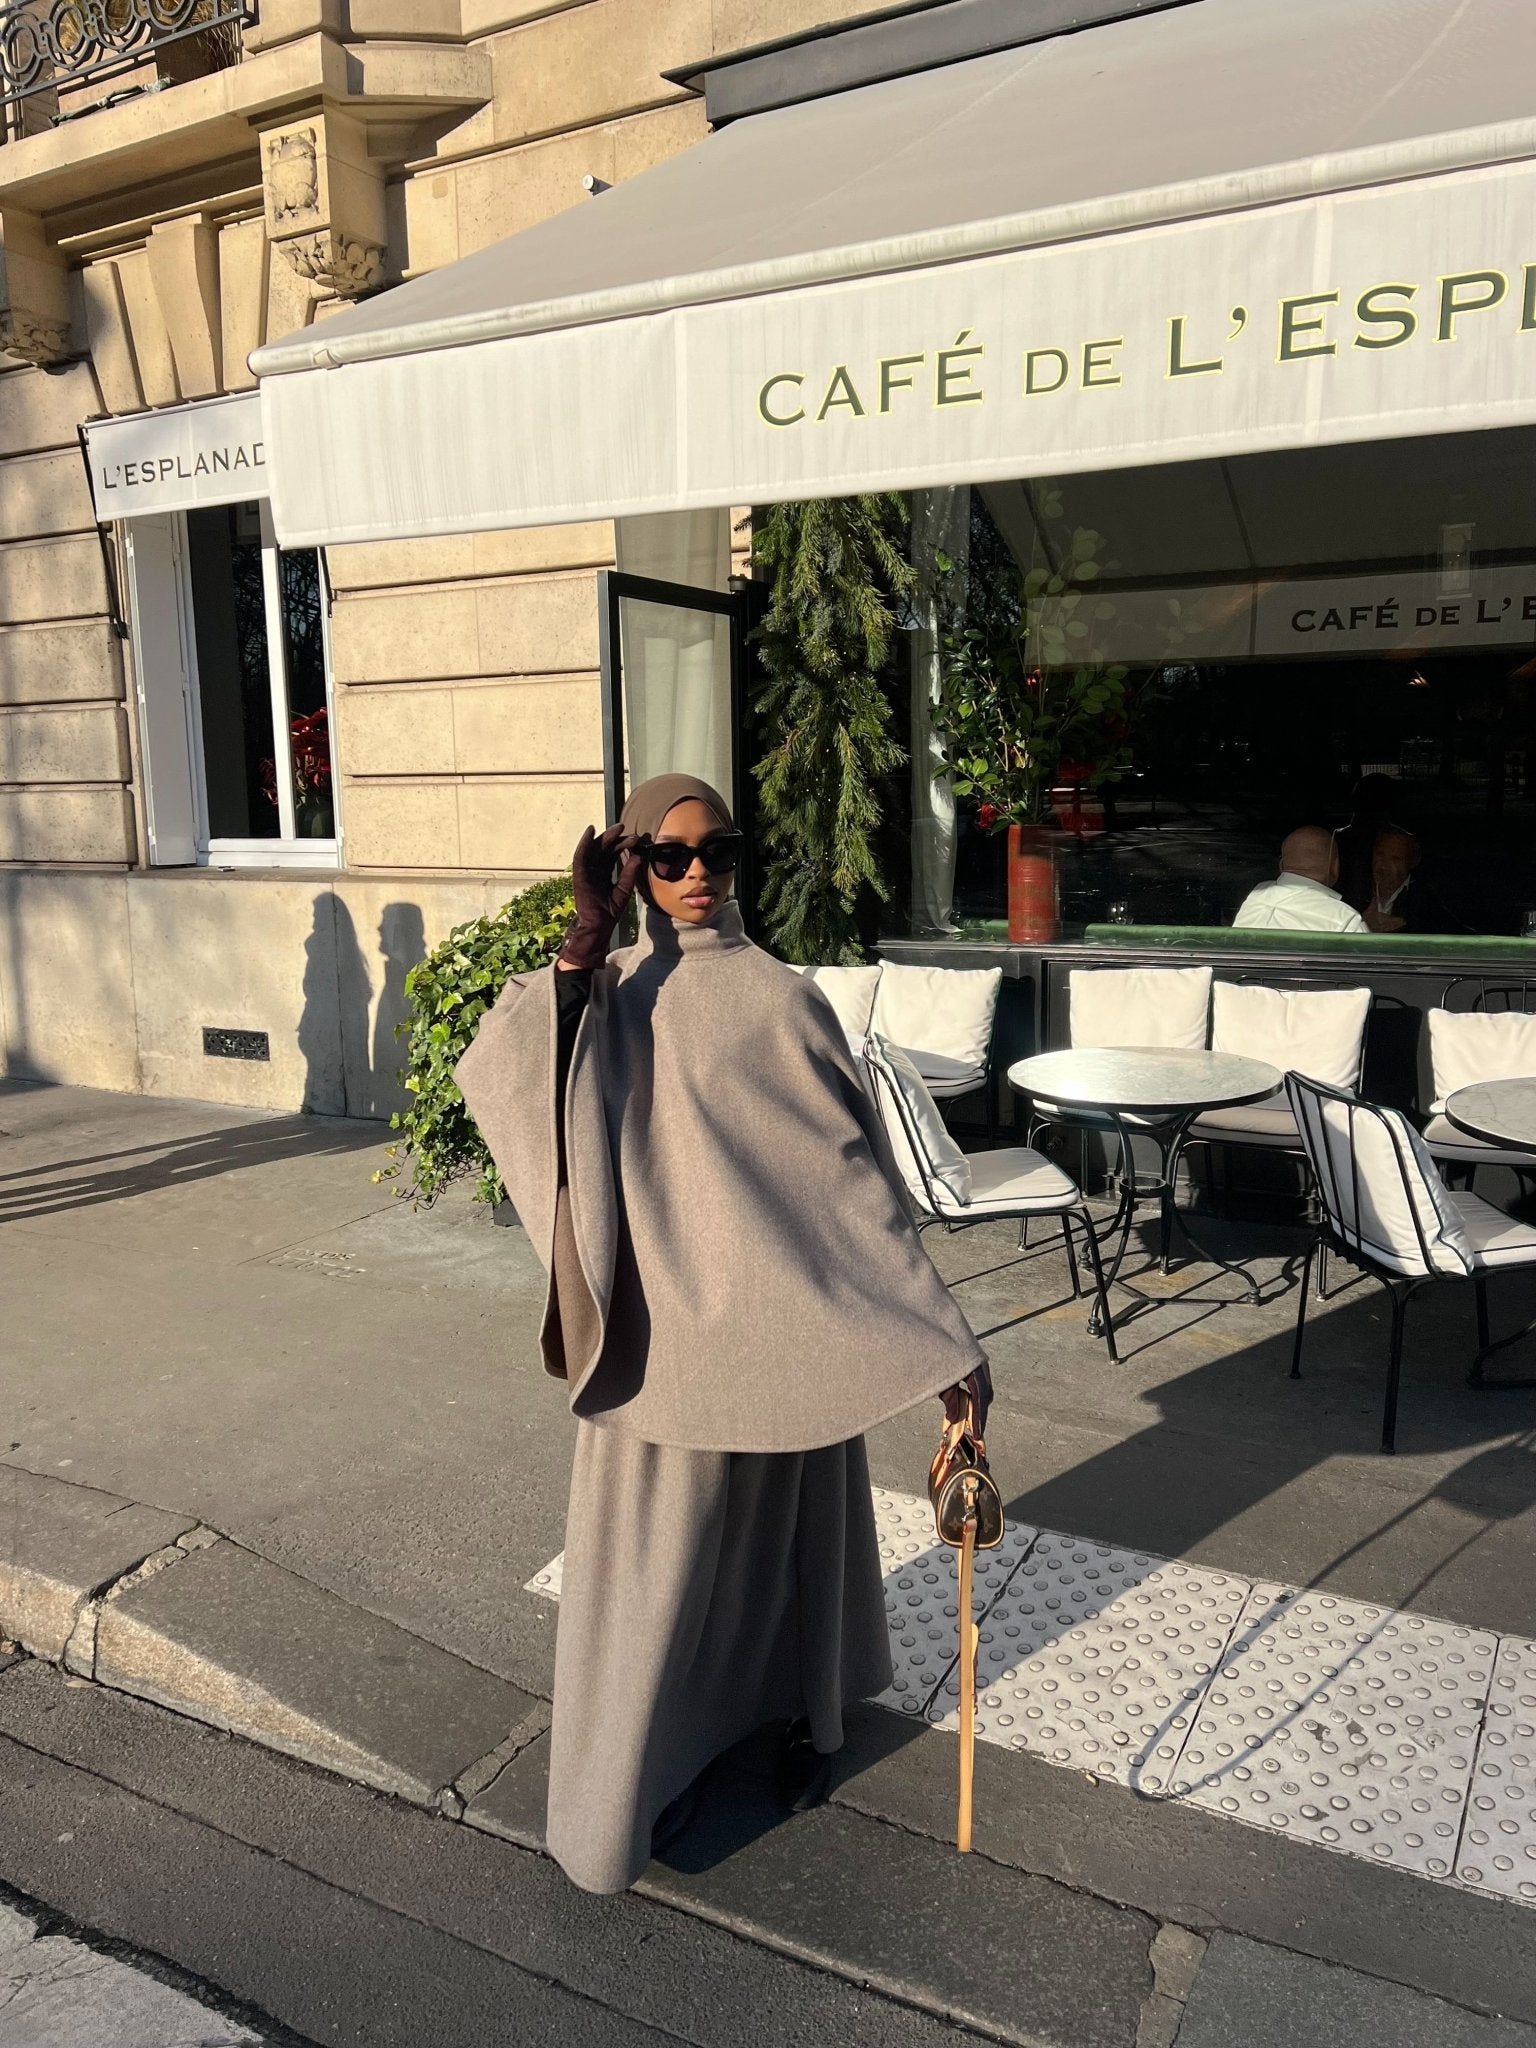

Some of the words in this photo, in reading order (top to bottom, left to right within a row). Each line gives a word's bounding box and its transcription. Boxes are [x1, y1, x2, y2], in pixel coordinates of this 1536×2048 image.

[758, 327, 984, 427] CAFÉ
[1024, 335, 1124, 397] DE
[1291, 597, 1399, 632] CAFÉ
[1415, 605, 1460, 626] DE
